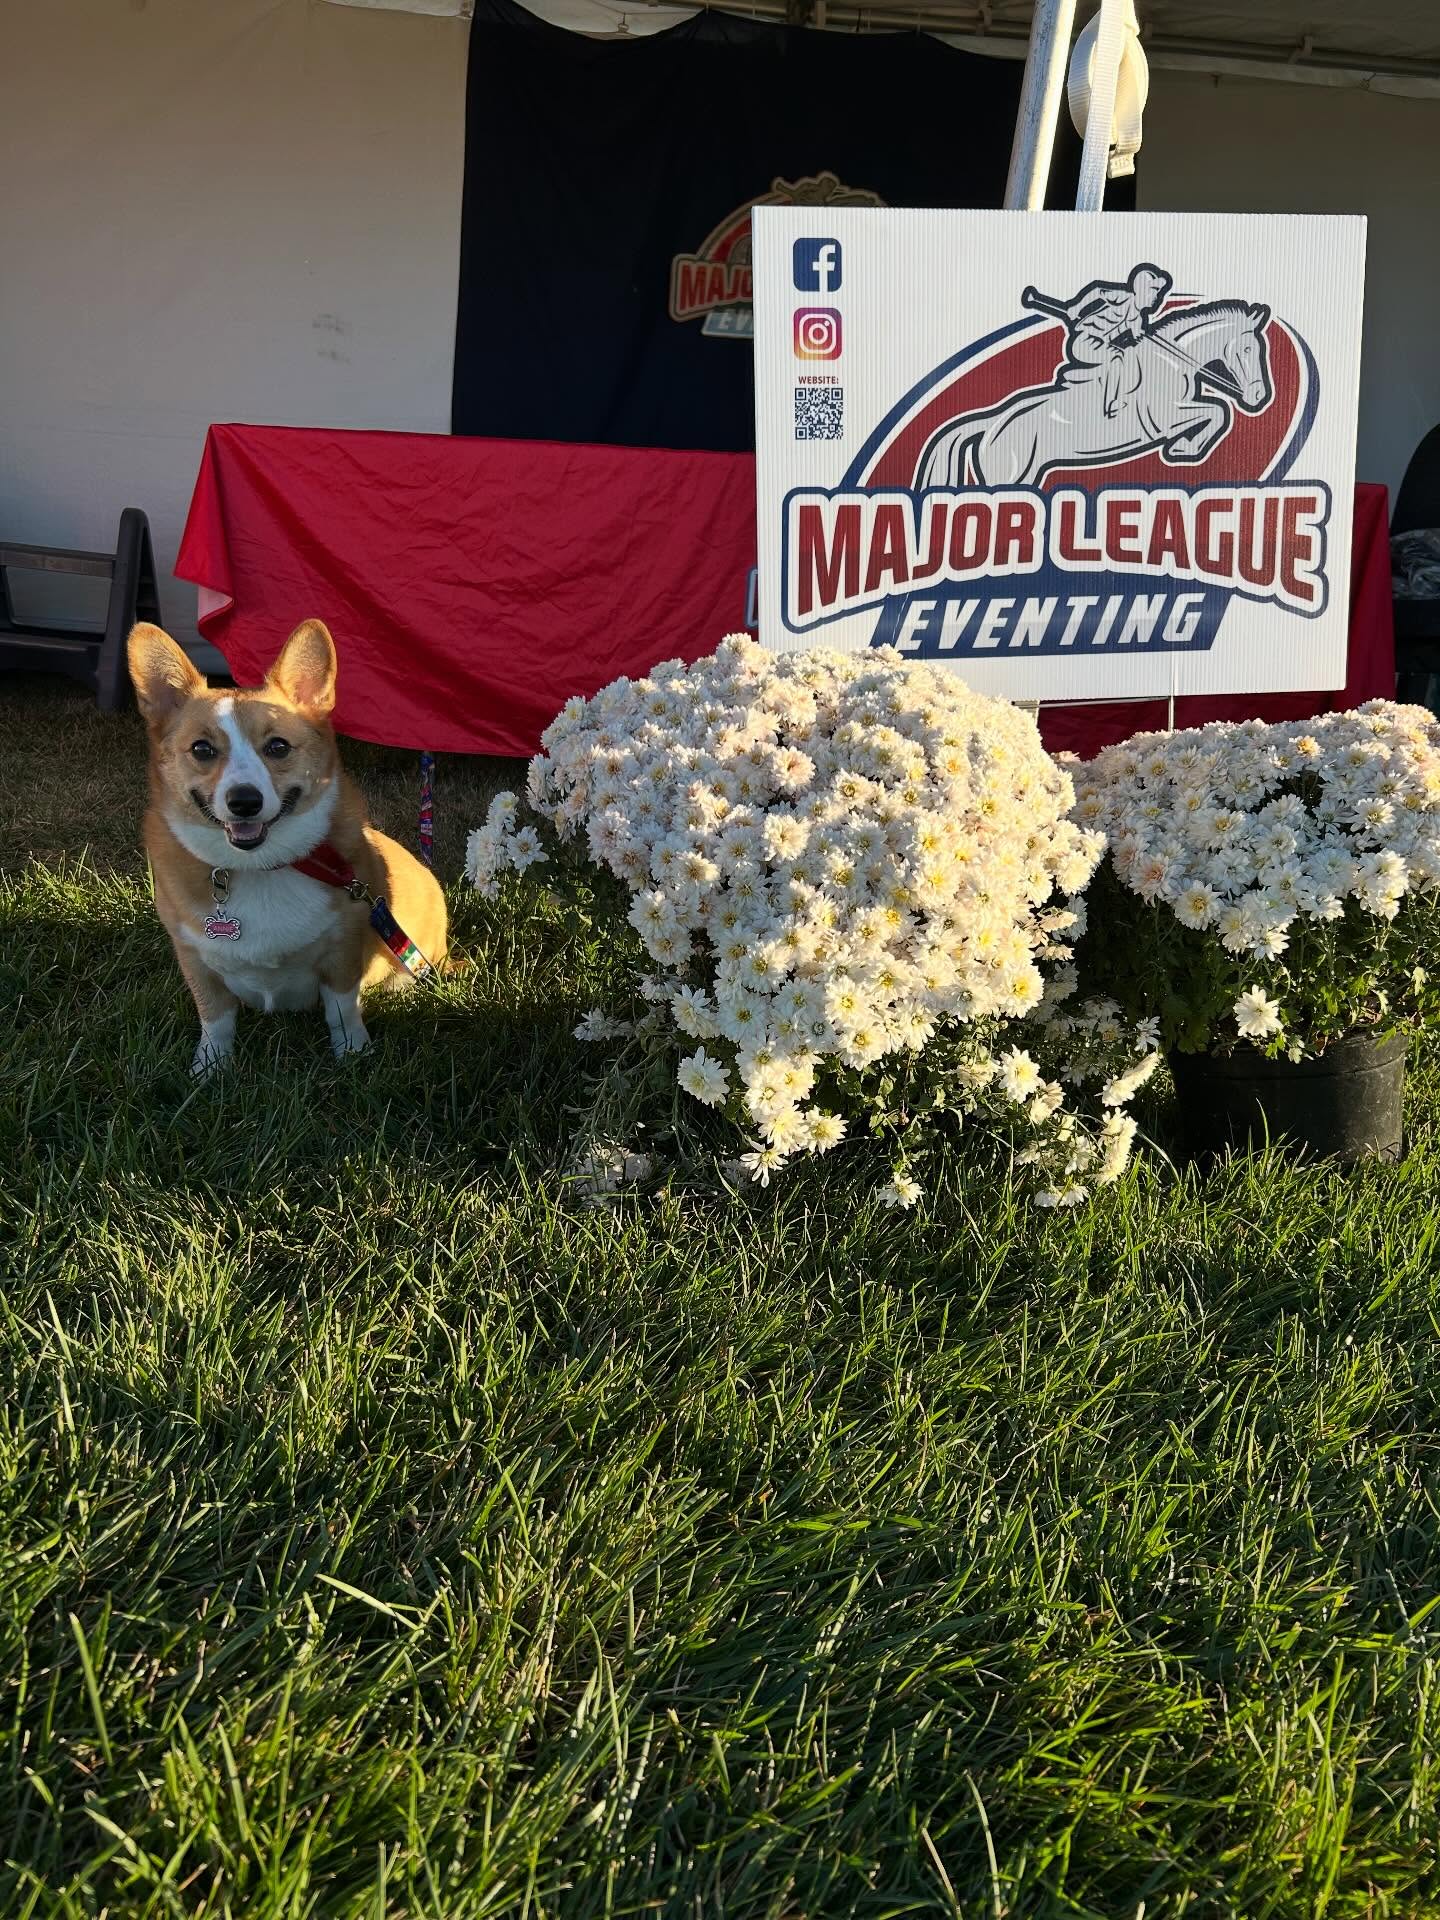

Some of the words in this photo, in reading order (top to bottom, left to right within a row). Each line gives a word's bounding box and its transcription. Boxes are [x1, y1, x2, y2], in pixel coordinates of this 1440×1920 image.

[680, 265, 753, 310] MAJO
[798, 376, 839, 385] WEBSITE:
[798, 502, 1037, 614] MAJOR
[1059, 496, 1317, 600] LEAGUE
[904, 592, 1205, 651] EVENTING
